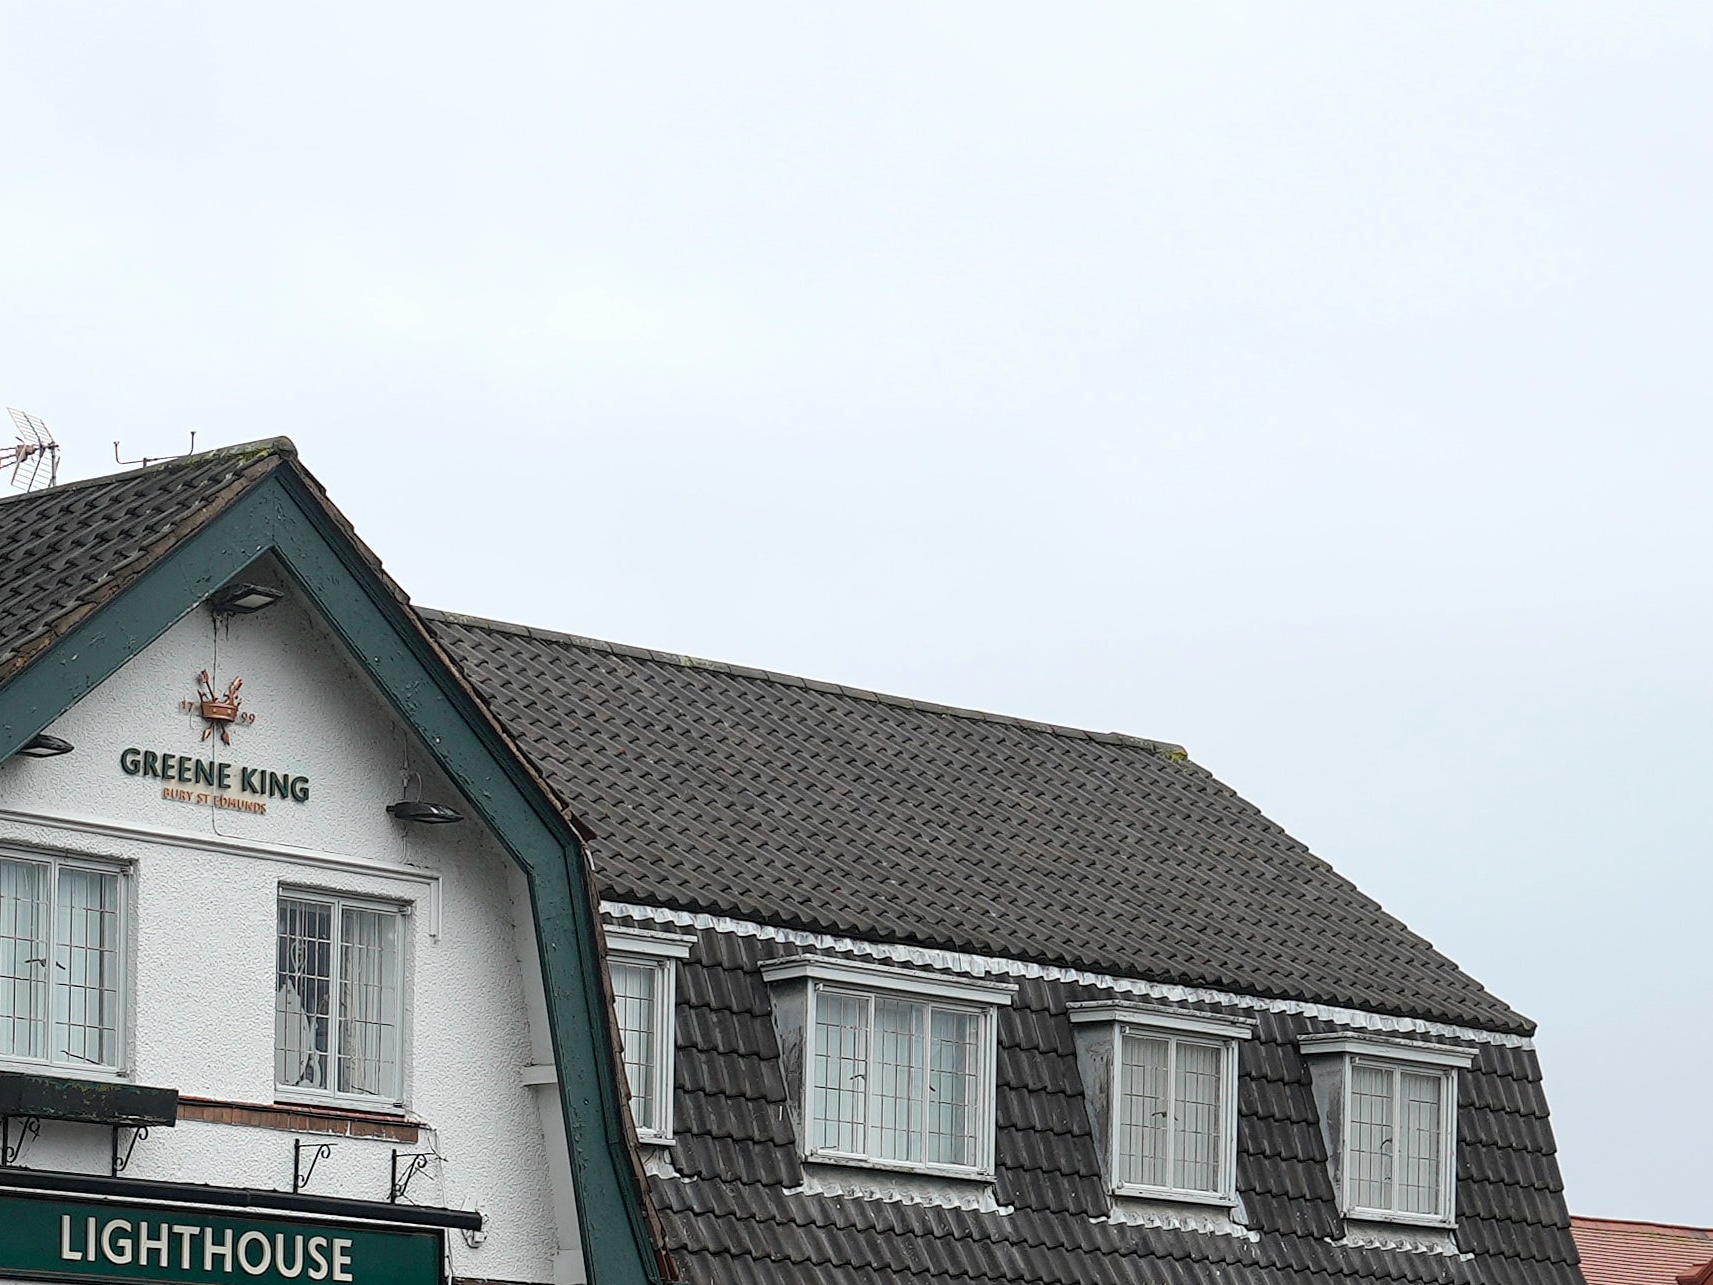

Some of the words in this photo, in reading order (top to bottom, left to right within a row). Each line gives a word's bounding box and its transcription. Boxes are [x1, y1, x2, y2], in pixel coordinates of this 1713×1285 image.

[119, 747, 232, 791] GREENE
[240, 766, 310, 803] KING
[162, 785, 195, 804] BURY
[195, 790, 212, 806] ST
[213, 793, 267, 815] EDMUNDS
[60, 1213, 354, 1283] LIGHTHOUSE
